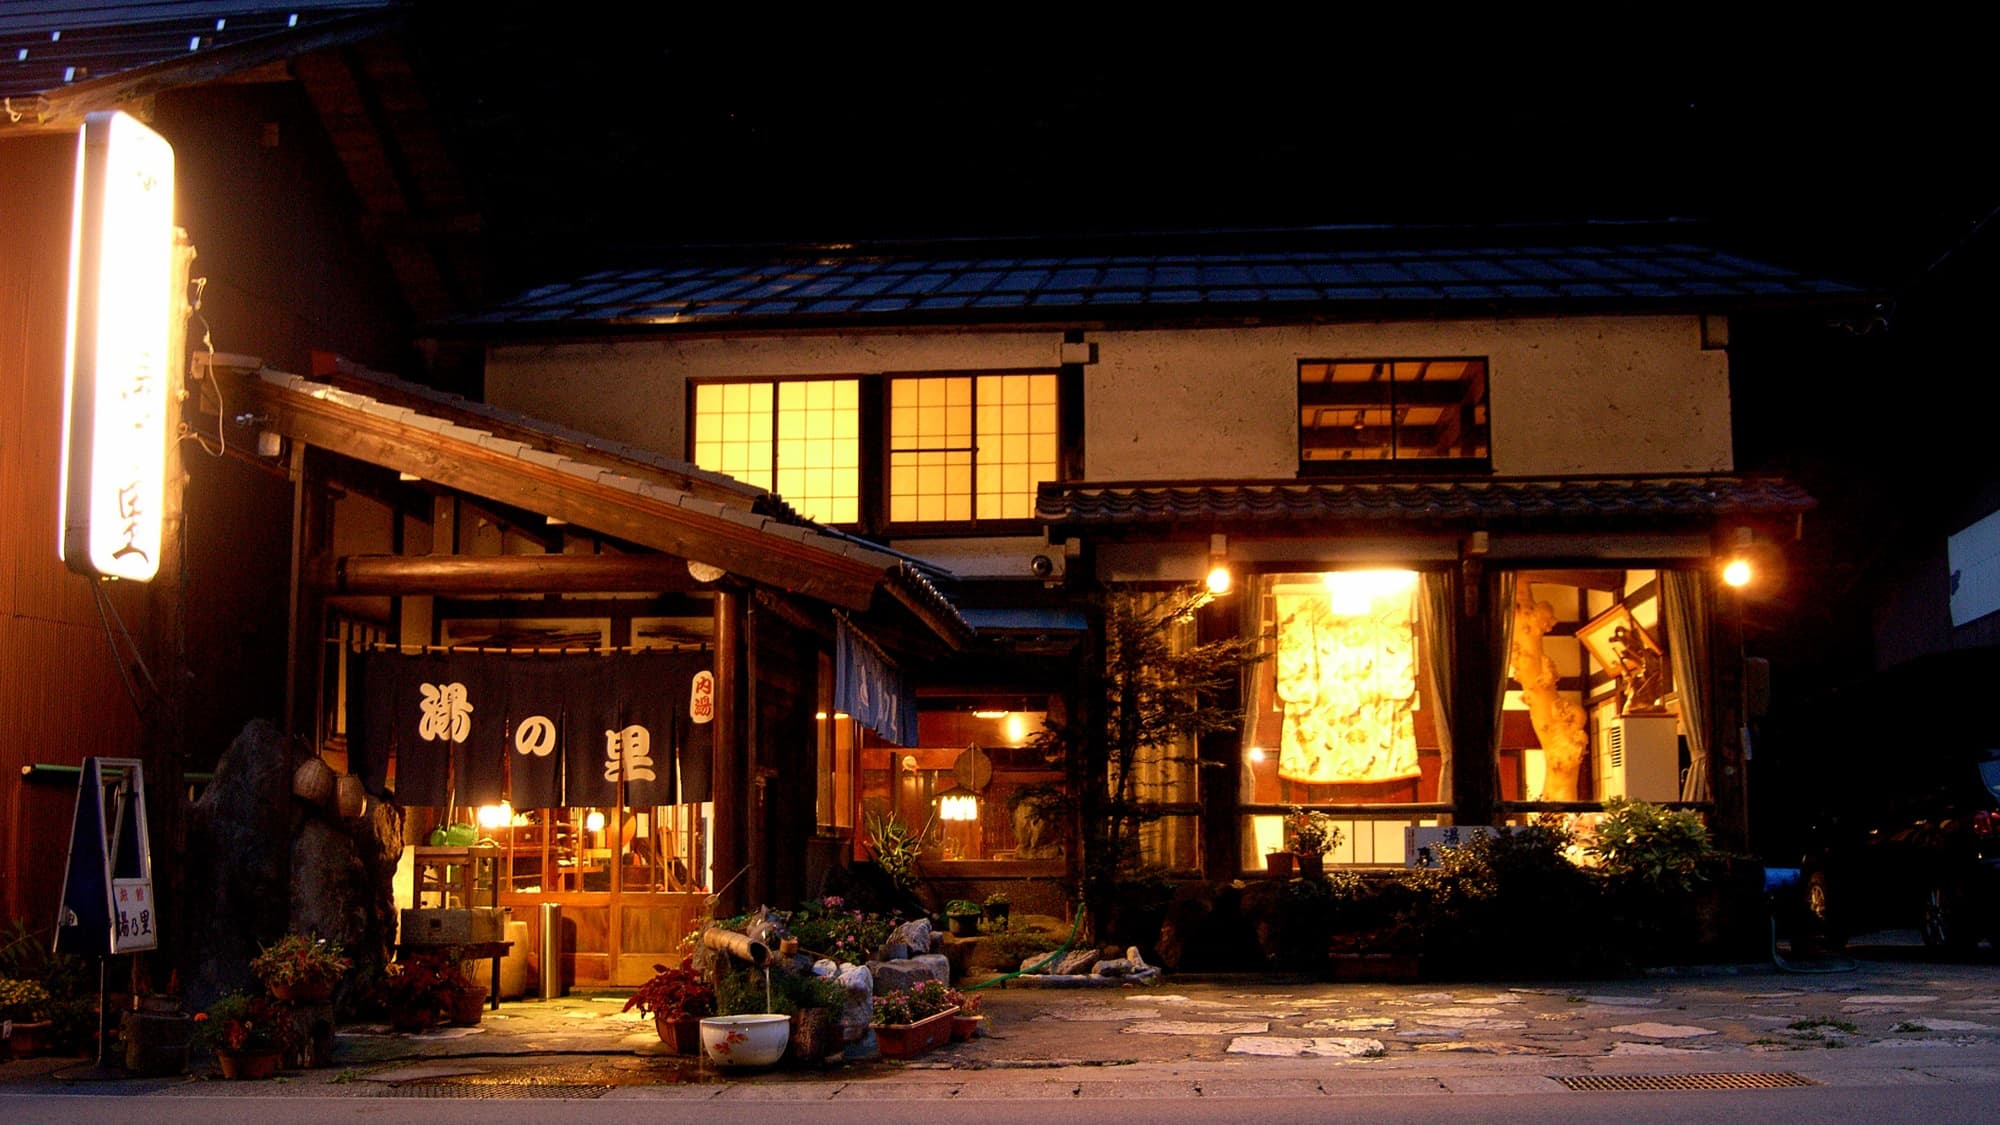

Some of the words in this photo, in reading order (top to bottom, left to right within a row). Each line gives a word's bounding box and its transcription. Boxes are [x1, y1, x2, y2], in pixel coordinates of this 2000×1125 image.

[695, 676, 712, 716] 内湯
[419, 682, 656, 782] 湯の里
